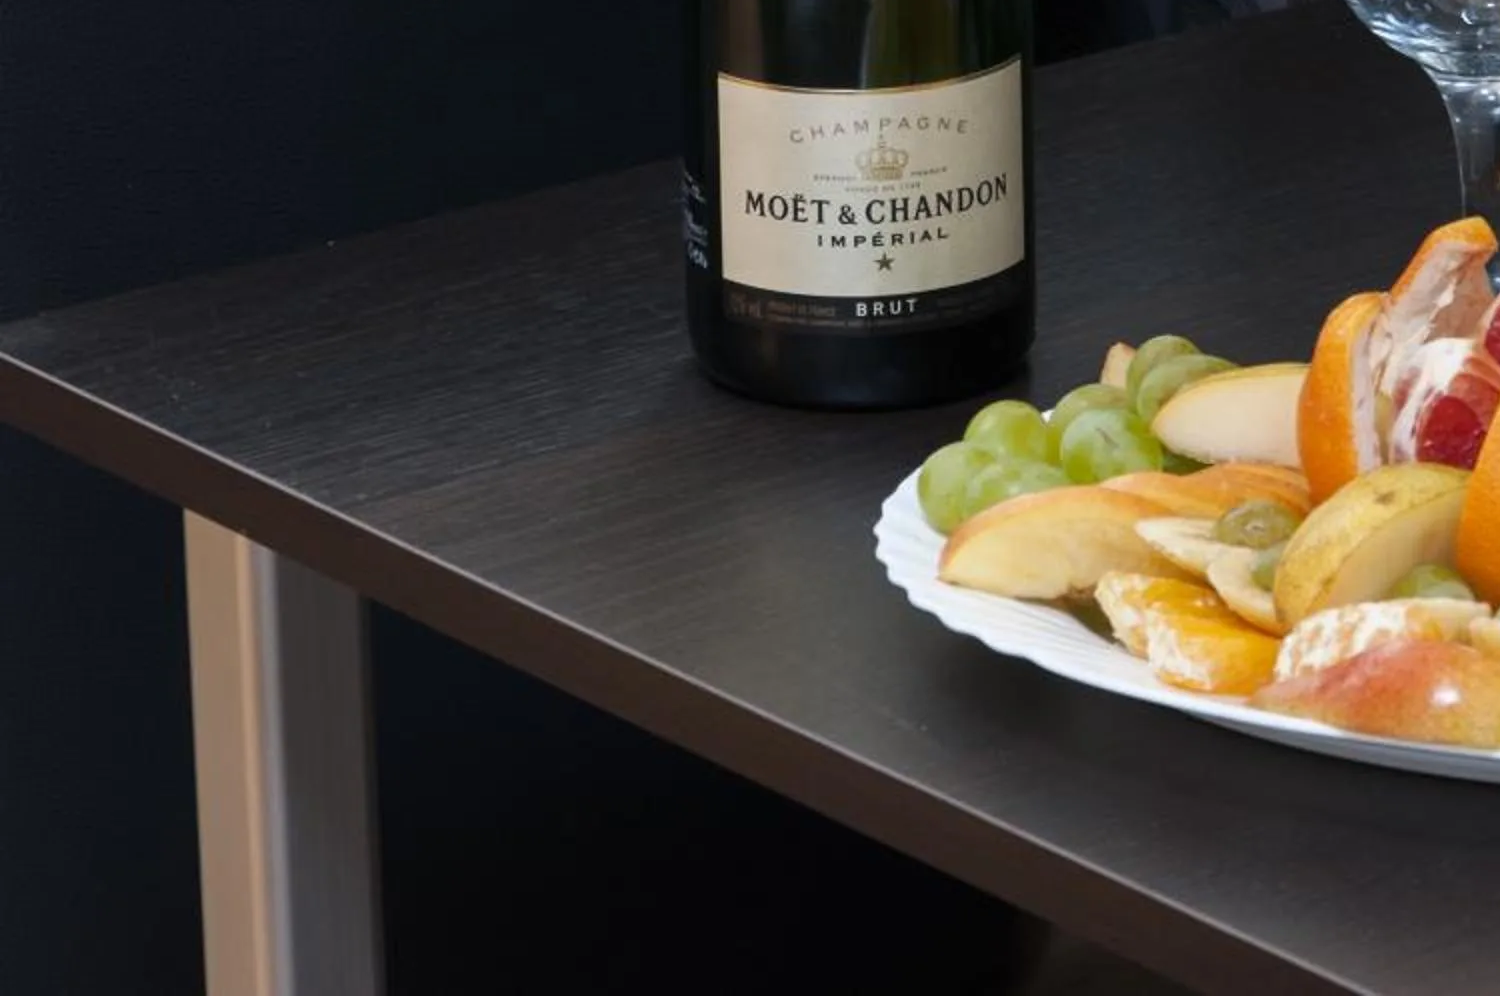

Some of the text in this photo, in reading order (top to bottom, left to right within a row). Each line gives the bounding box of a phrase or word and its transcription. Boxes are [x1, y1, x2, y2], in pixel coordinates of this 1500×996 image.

[789, 116, 971, 144] CHAMPAGNE
[745, 172, 1008, 225] MOËT & CHANDON
[817, 227, 949, 248] IMPÉRIAL
[856, 298, 919, 317] BRUT
